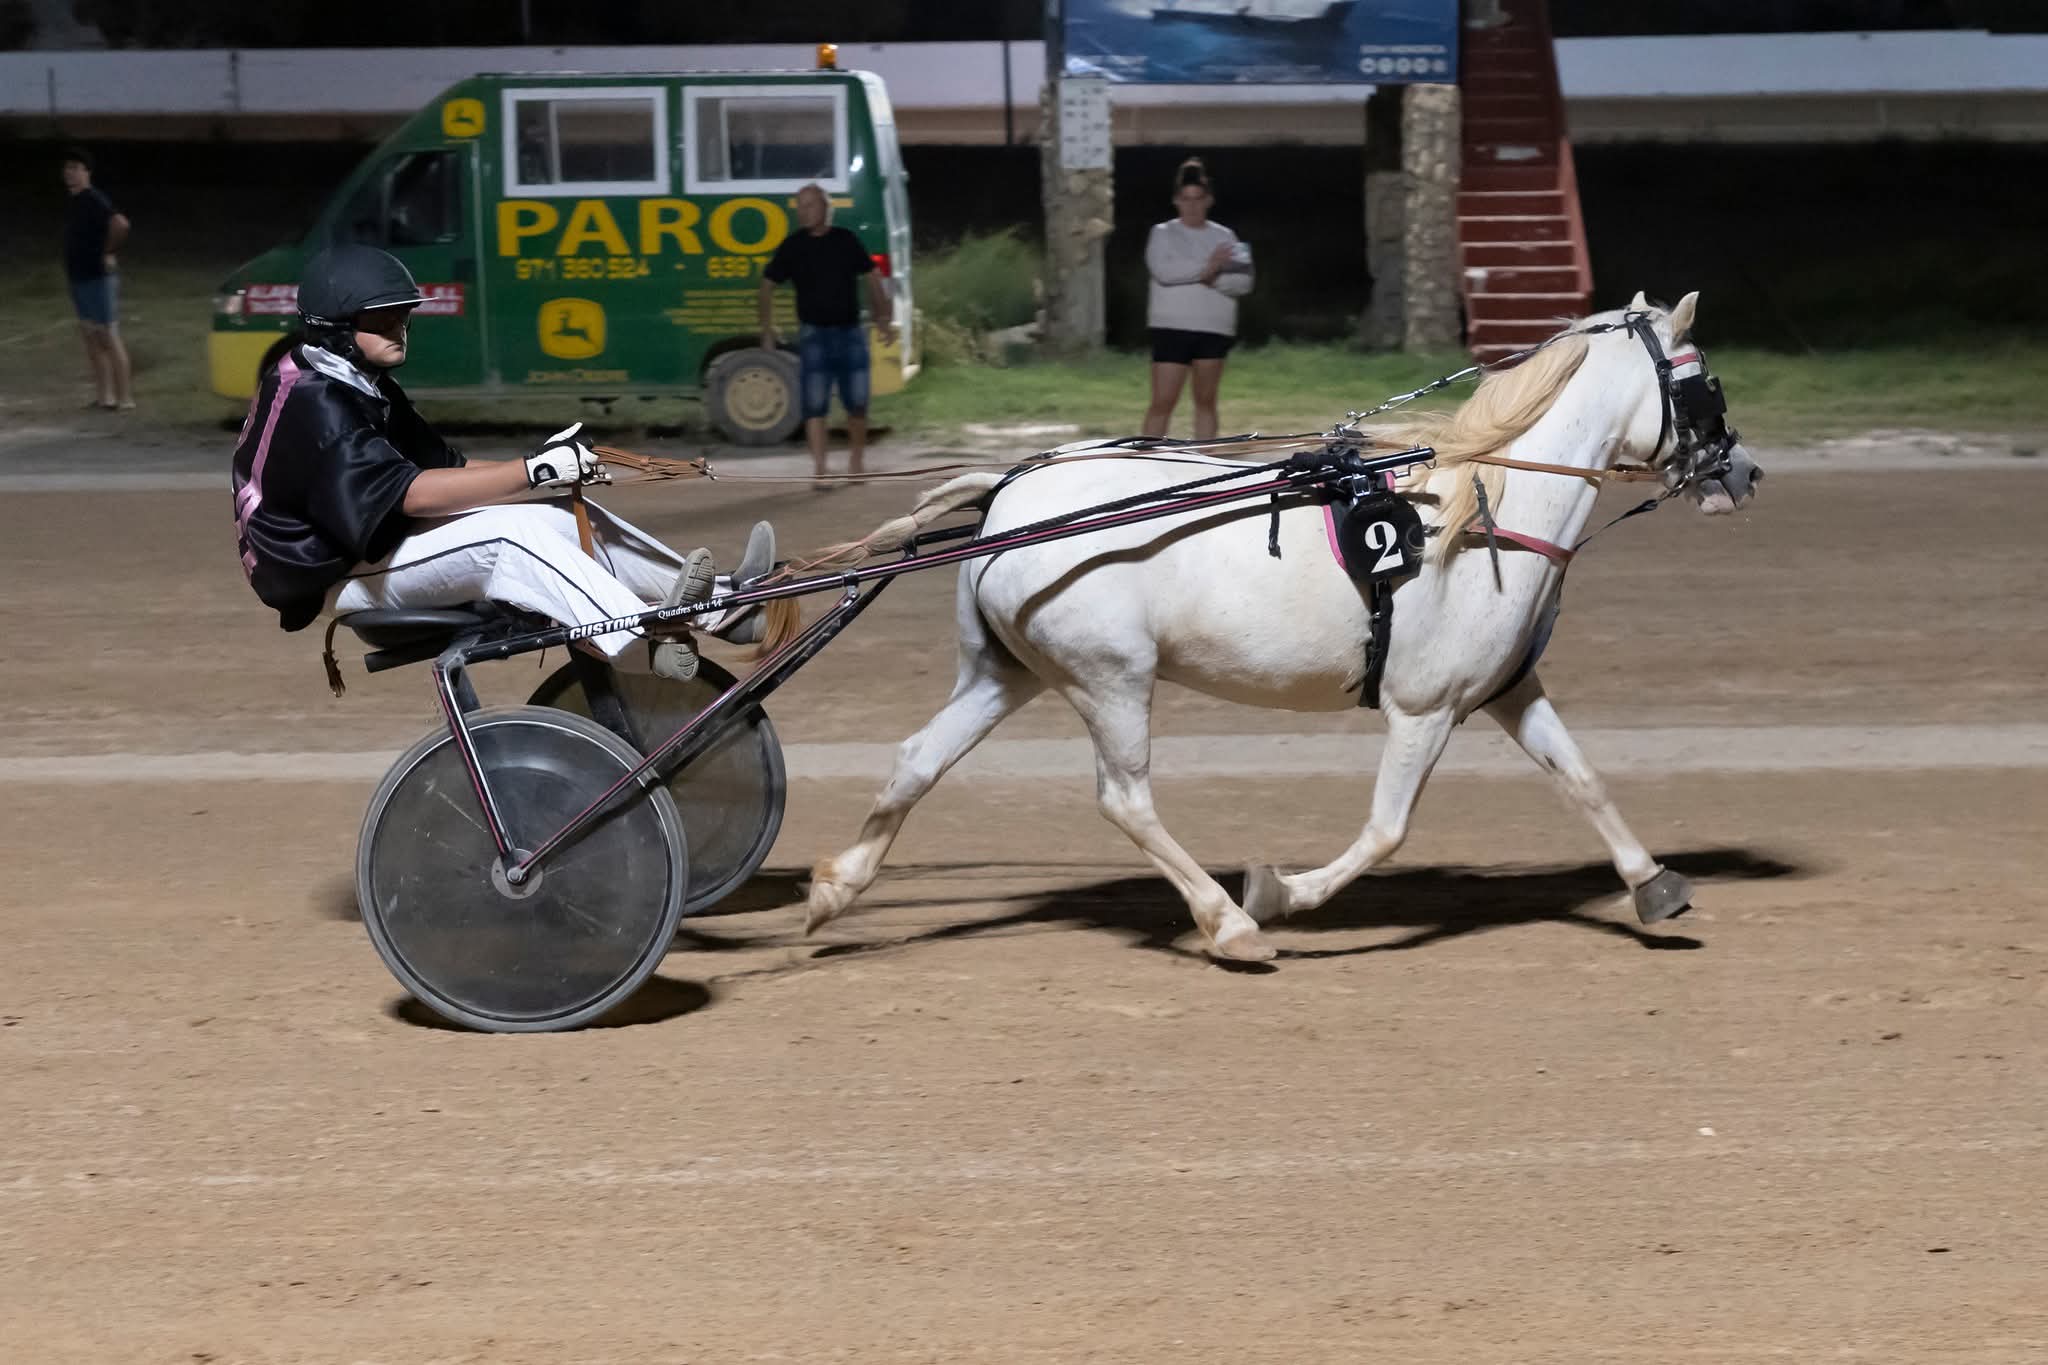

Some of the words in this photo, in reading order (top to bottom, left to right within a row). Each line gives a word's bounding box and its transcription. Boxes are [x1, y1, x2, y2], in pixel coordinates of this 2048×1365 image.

[1364, 520, 1405, 575] 2
[569, 616, 640, 641] CUSTOM
[658, 605, 691, 620] Quadres
